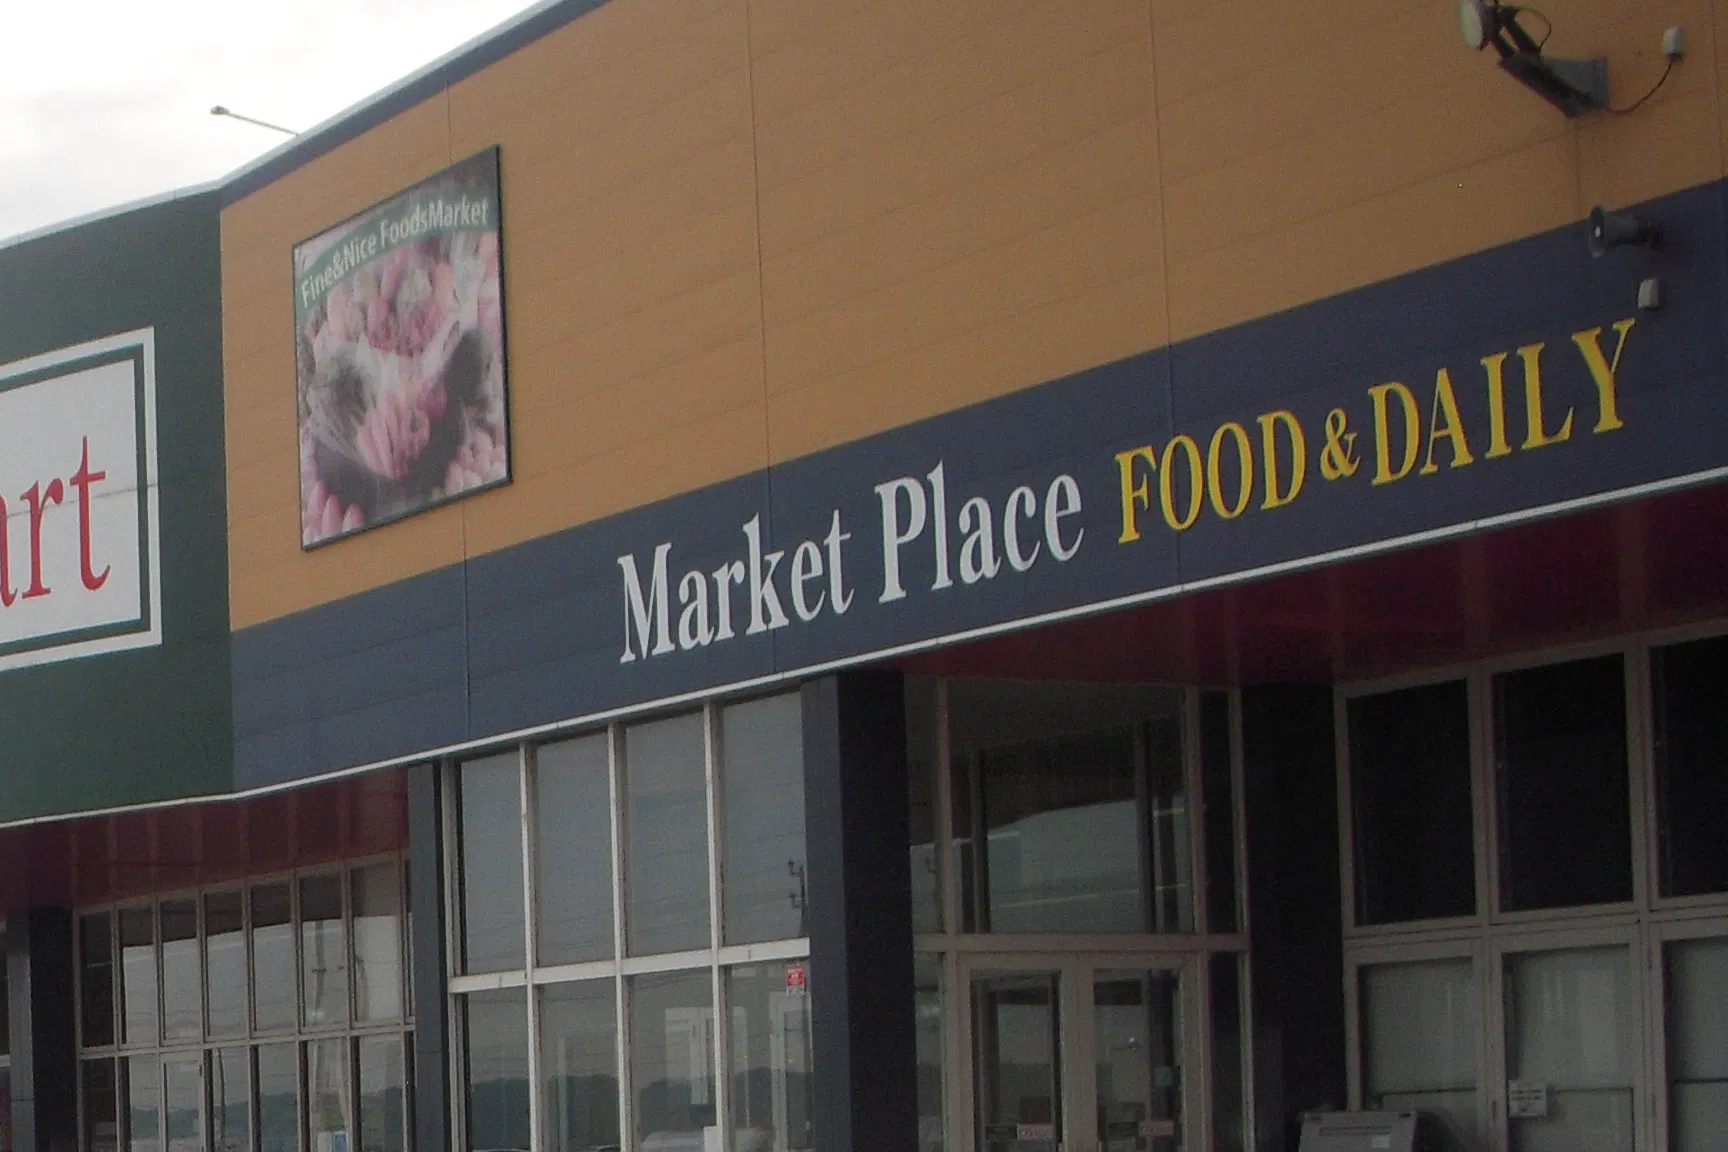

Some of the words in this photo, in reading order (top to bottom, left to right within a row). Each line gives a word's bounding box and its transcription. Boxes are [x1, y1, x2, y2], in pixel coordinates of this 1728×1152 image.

[300, 232, 377, 308] Fine&Nice
[616, 508, 854, 664] Market
[875, 460, 1084, 604] Place
